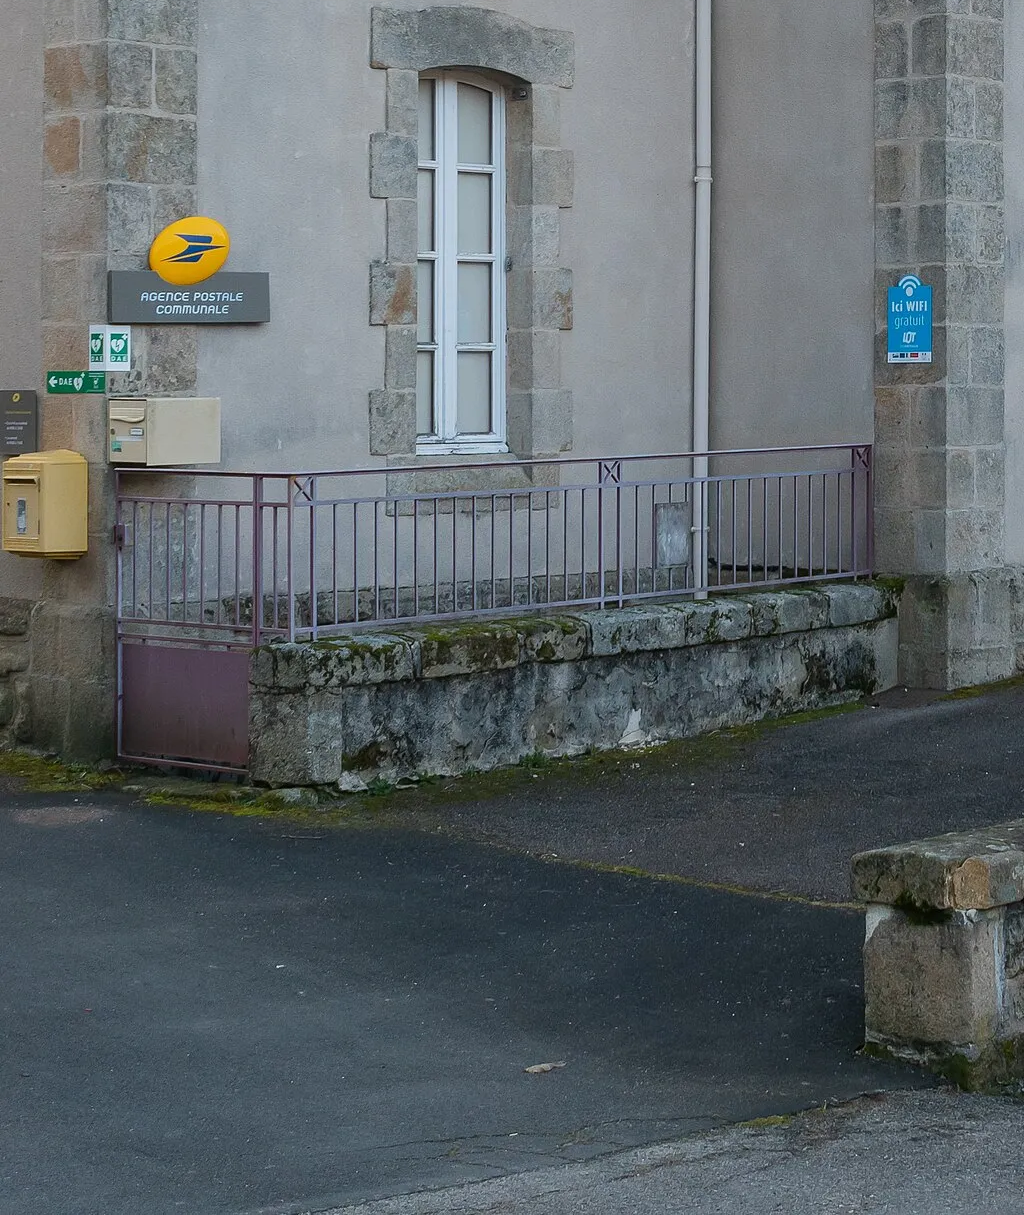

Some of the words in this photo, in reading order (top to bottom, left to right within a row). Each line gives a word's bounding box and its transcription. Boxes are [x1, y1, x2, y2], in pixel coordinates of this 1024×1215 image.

[140, 292, 190, 302] AGENCE
[193, 292, 244, 302] POSTALE
[156, 305, 230, 315] COMMUNALE
[891, 300, 903, 312] Ici
[906, 301, 927, 312] WIFI
[894, 315, 924, 329] gratuit
[58, 377, 73, 386] DAE
